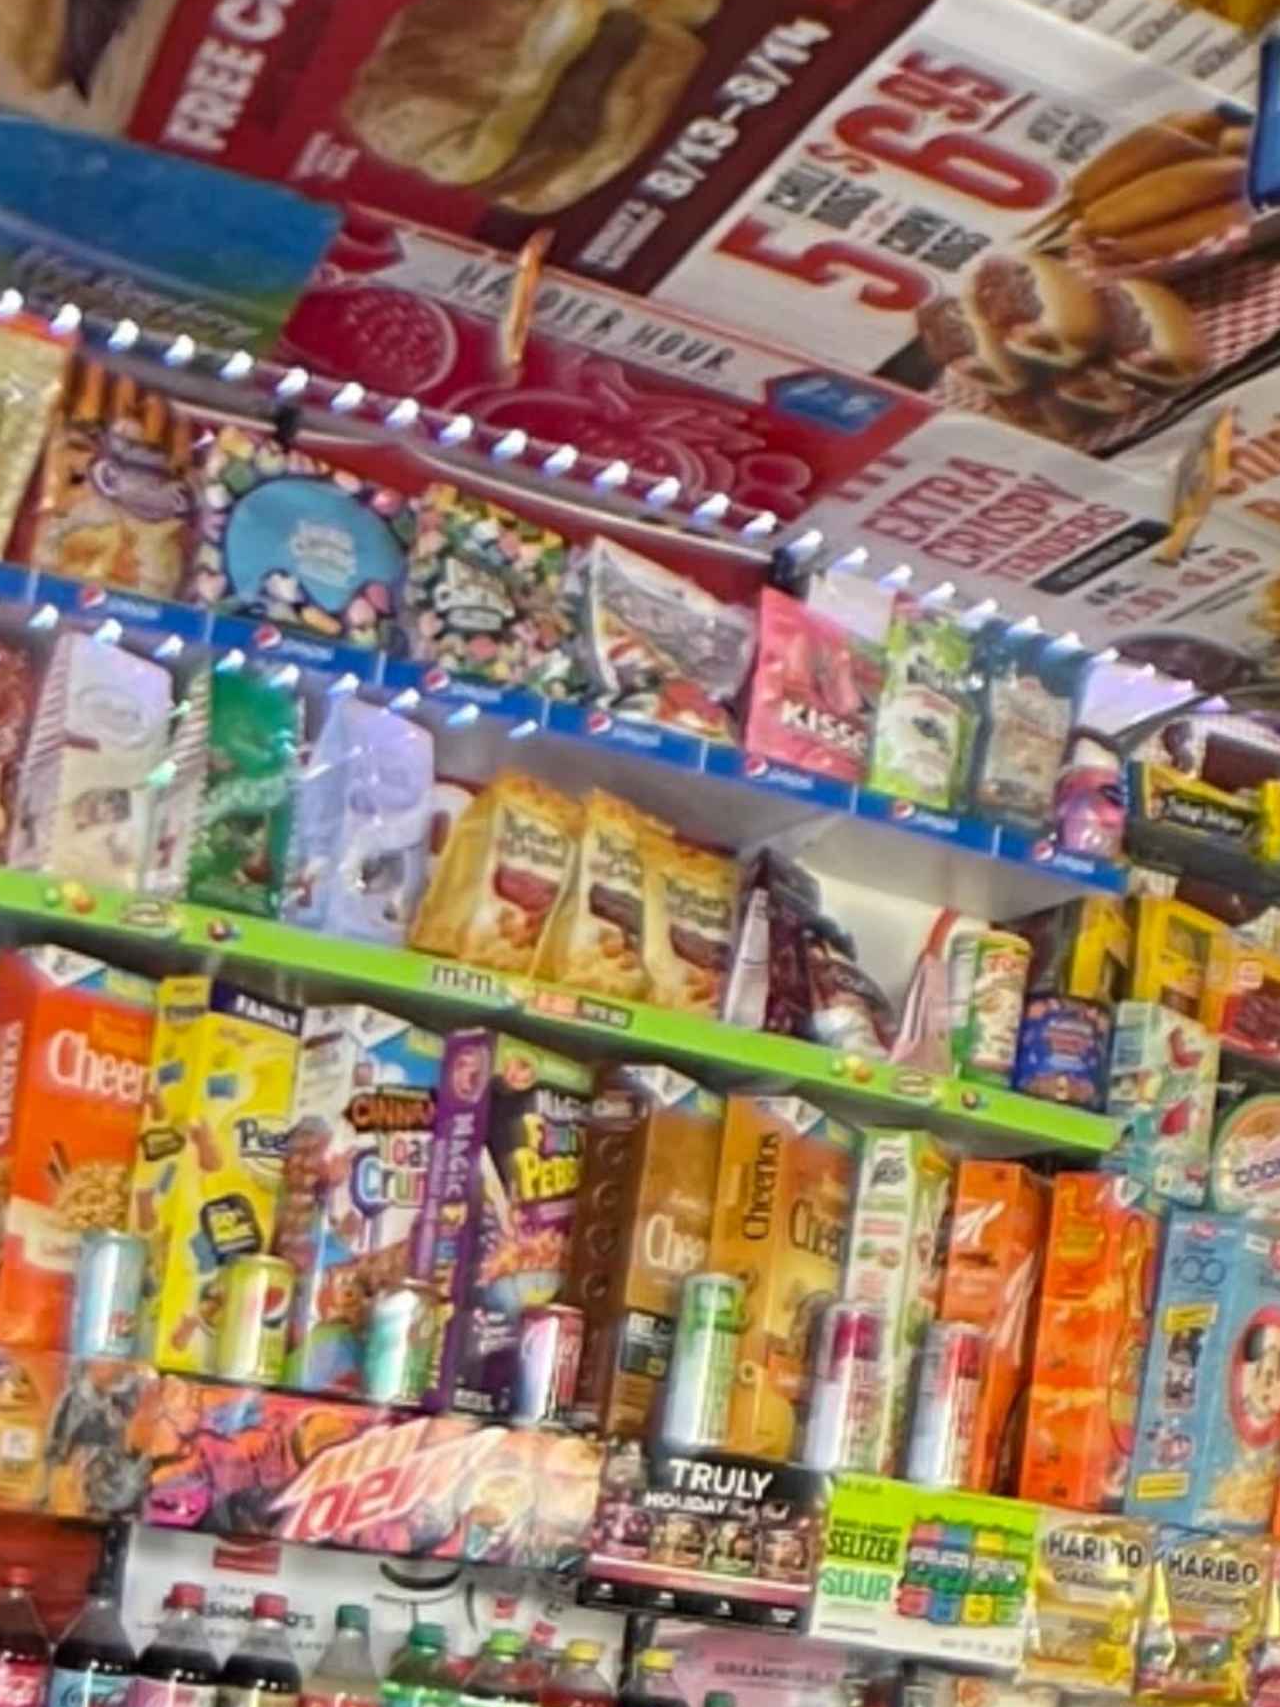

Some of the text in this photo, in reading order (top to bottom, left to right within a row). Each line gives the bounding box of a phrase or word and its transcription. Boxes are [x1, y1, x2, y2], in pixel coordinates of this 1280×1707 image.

[164, 35, 264, 156] FREE
[716, 217, 933, 312] 5
[861, 455, 1014, 546] EXTRA
[920, 475, 1069, 572] CRISPY
[234, 995, 299, 1032] FAMILY
[742, 1130, 782, 1242] Cheerios
[668, 1458, 777, 1501] TRULY
[643, 1491, 730, 1515] HOLIDAY
[827, 1529, 900, 1562] SELTZER
[1167, 1546, 1259, 1586] HARIBO
[820, 1568, 894, 1603] SOUR
